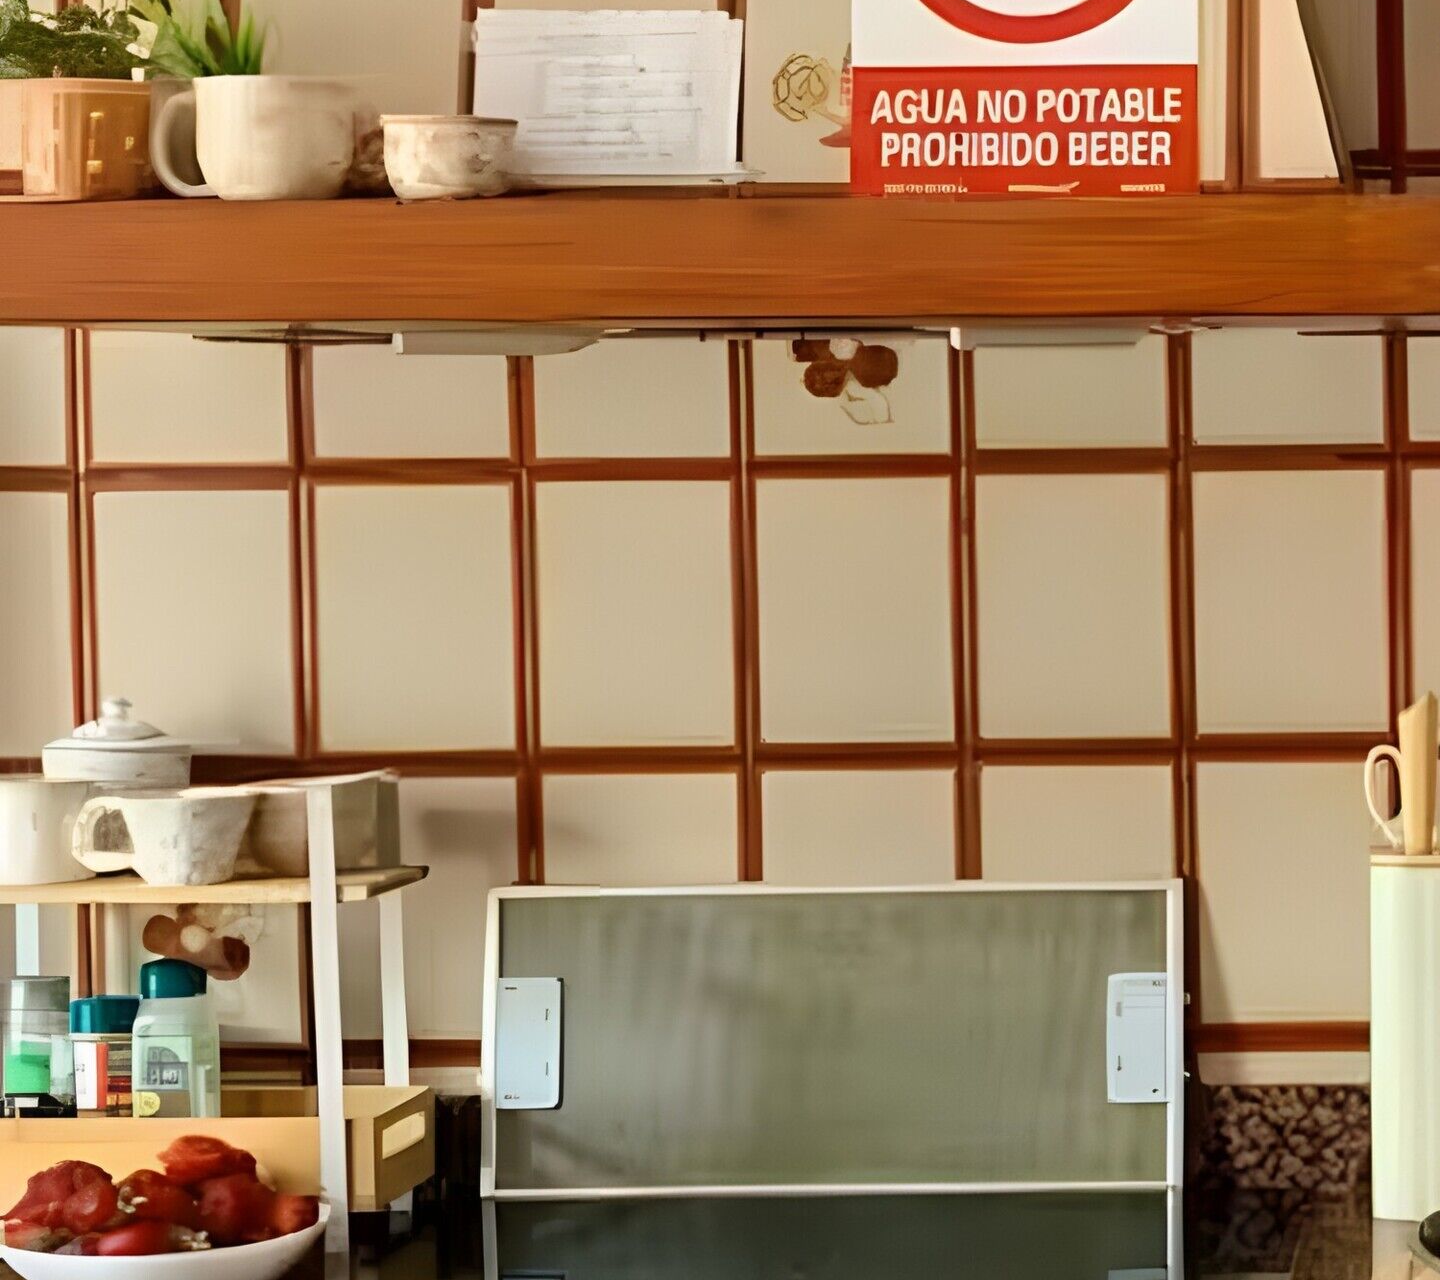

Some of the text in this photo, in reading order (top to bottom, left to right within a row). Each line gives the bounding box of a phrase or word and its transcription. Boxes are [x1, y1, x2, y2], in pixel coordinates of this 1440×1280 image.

[870, 87, 1182, 125] AGUA NO POTABLE
[881, 130, 1171, 167] PROHIBIDO BEBER
